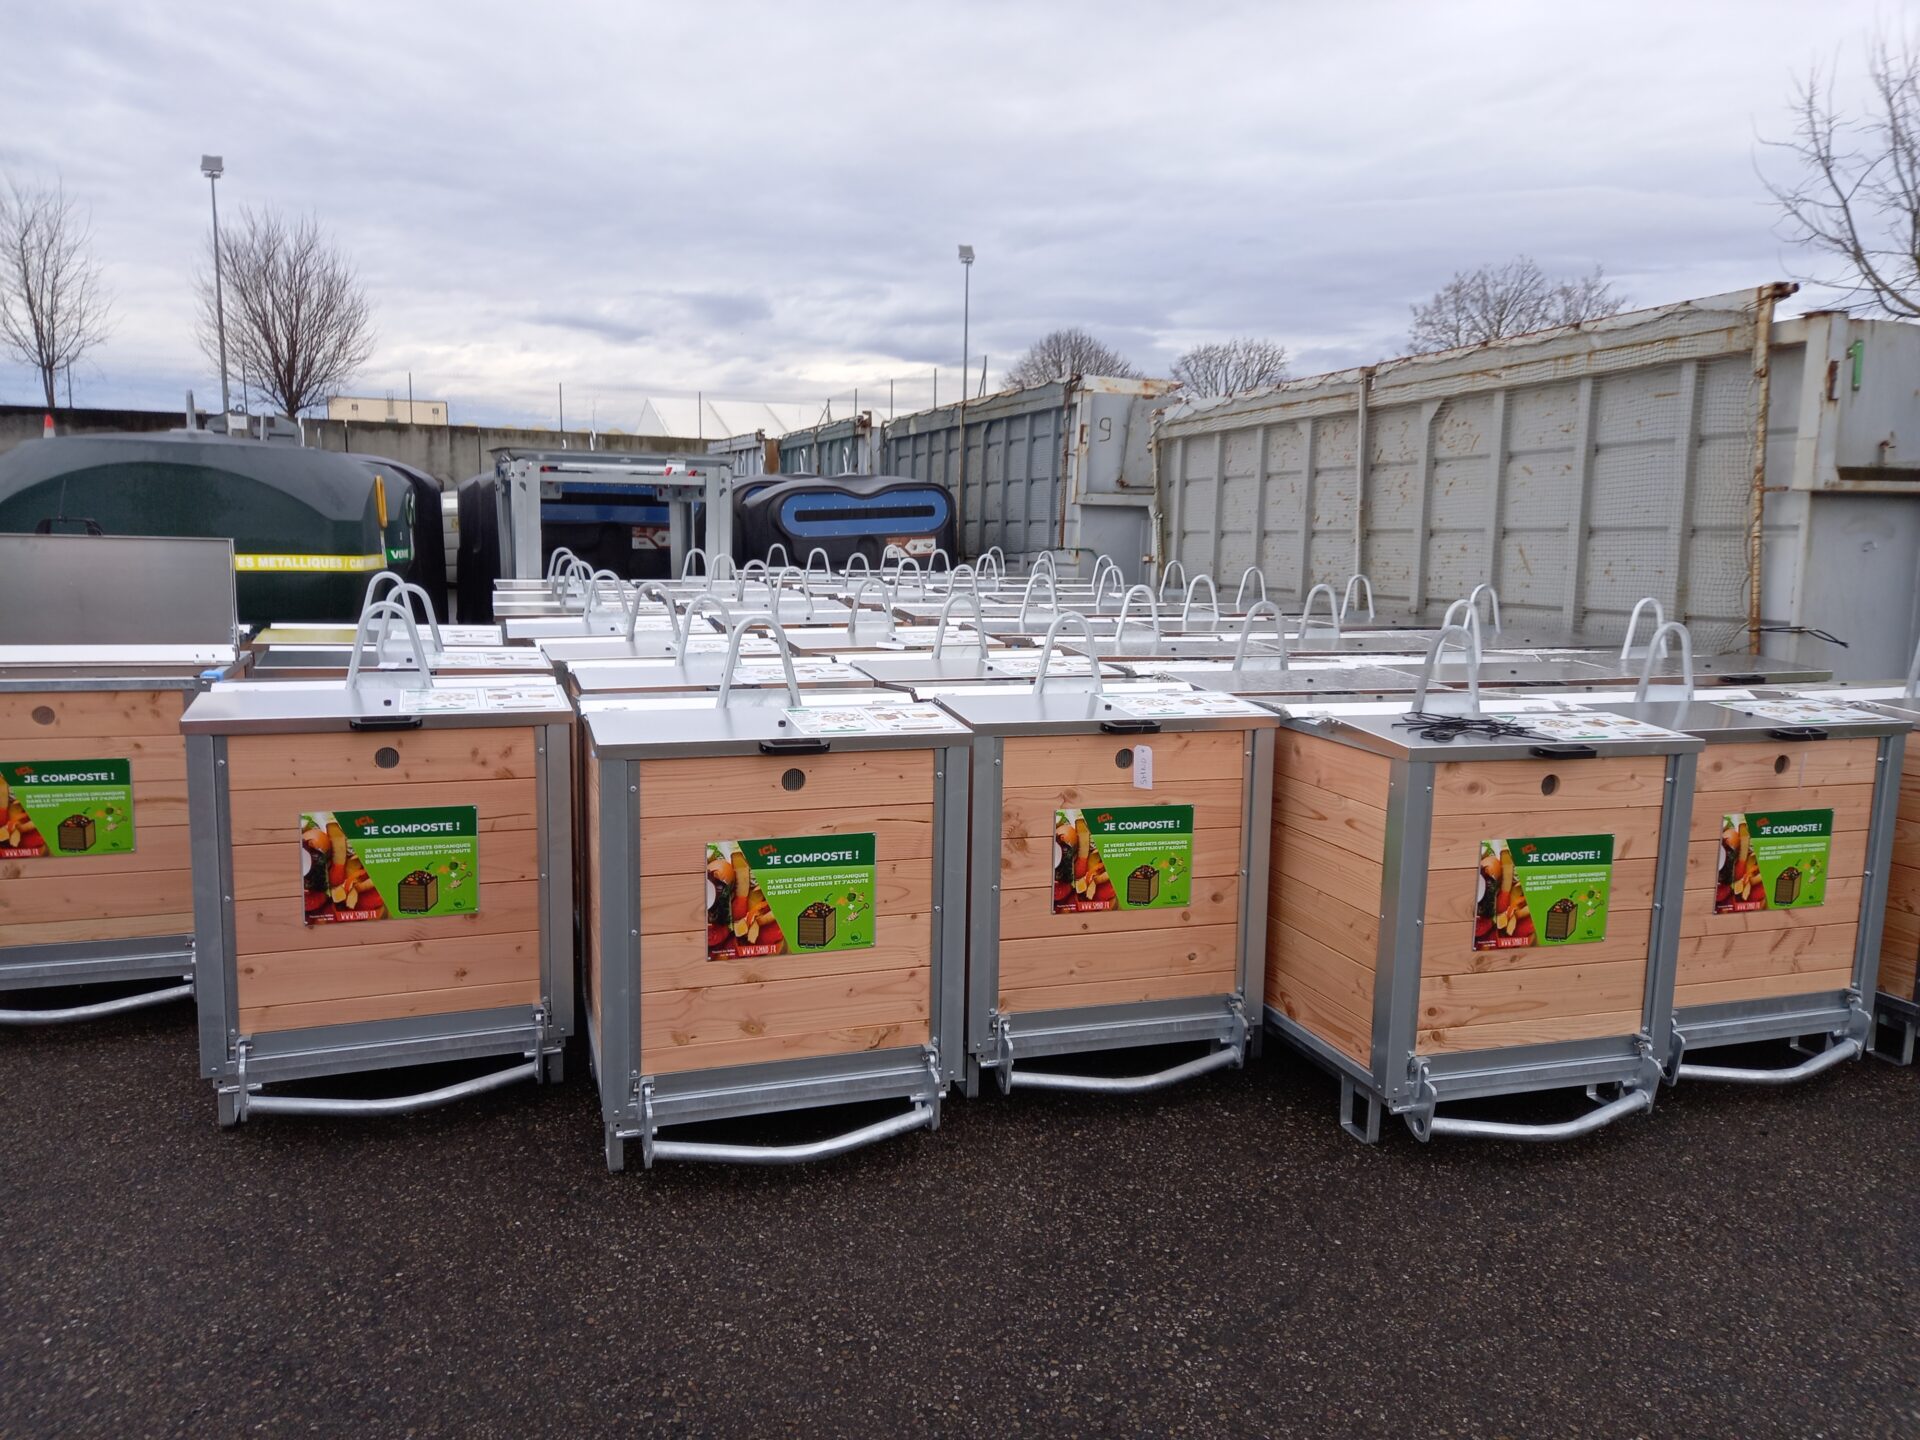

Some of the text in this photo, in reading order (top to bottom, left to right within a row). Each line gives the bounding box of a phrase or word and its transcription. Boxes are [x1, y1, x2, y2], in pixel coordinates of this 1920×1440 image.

[1846, 340, 1863, 391] 1
[1099, 417, 1112, 442] 9
[24, 775, 38, 783] JE
[41, 773, 108, 782] COMPOSTE
[364, 822, 460, 835] JE COMPOSTE !
[1104, 820, 1180, 831] JE COMPOSTE !
[1772, 824, 1817, 833] COMPOSTE
[767, 850, 859, 865] JE COMPOSTE !
[1527, 851, 1600, 862] JE COMPOSTE !
[833, 872, 868, 880] ORGANIQUES
[341, 910, 377, 920] WWW.SMND.FR
[743, 945, 776, 955] WWW.SMND.FR
